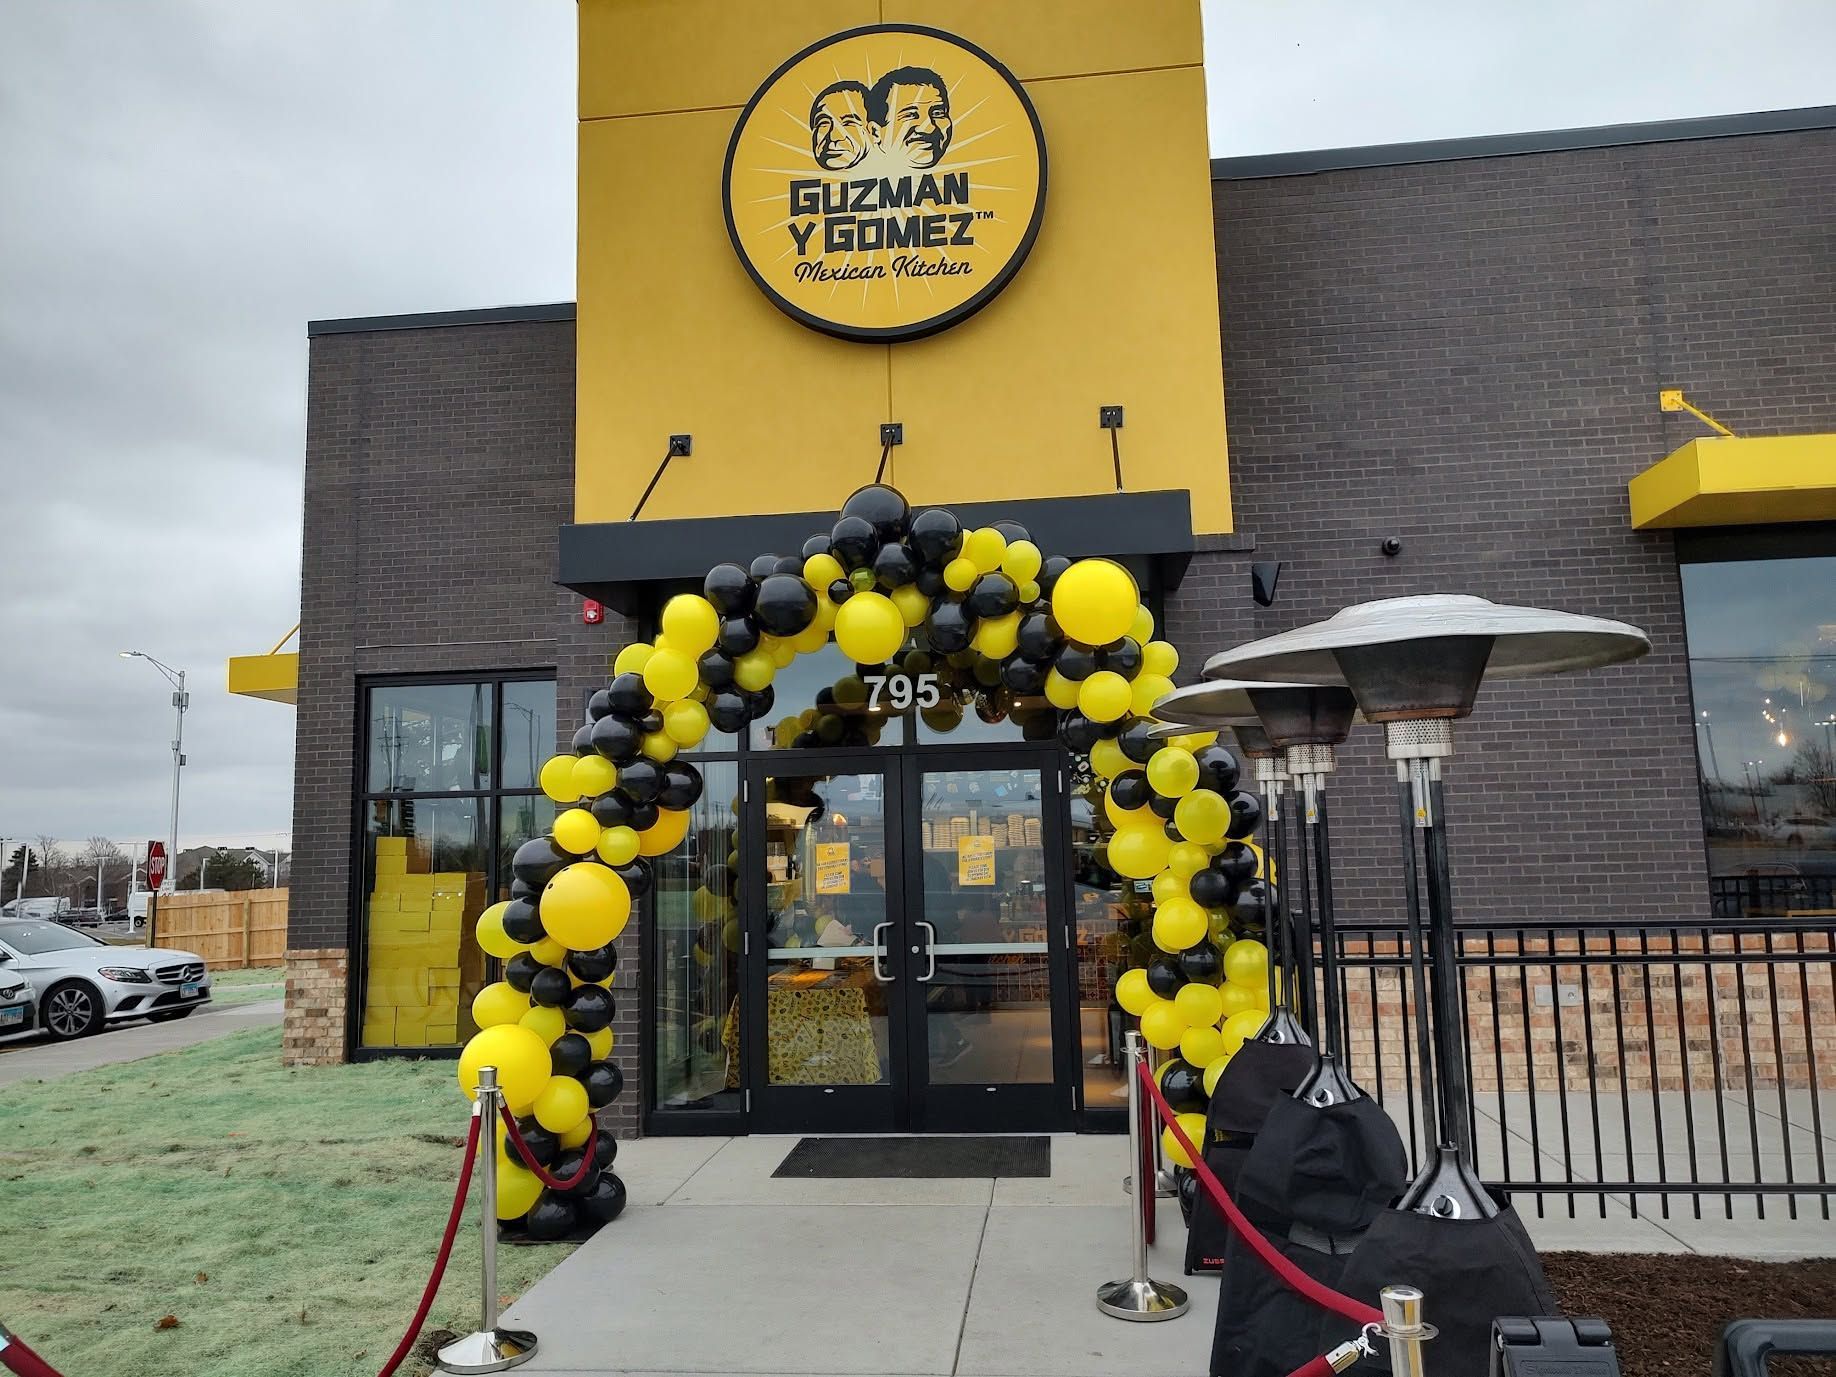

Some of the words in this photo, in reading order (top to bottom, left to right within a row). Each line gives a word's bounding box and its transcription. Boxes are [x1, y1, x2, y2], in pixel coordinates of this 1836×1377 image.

[790, 172, 969, 216] GUZMAN
[788, 221, 817, 256] Y
[824, 212, 974, 253] GOMEZ
[794, 261, 886, 283] Mexican
[892, 254, 972, 278] Kitchen
[863, 673, 940, 711] 795
[151, 856, 165, 875] STOP
